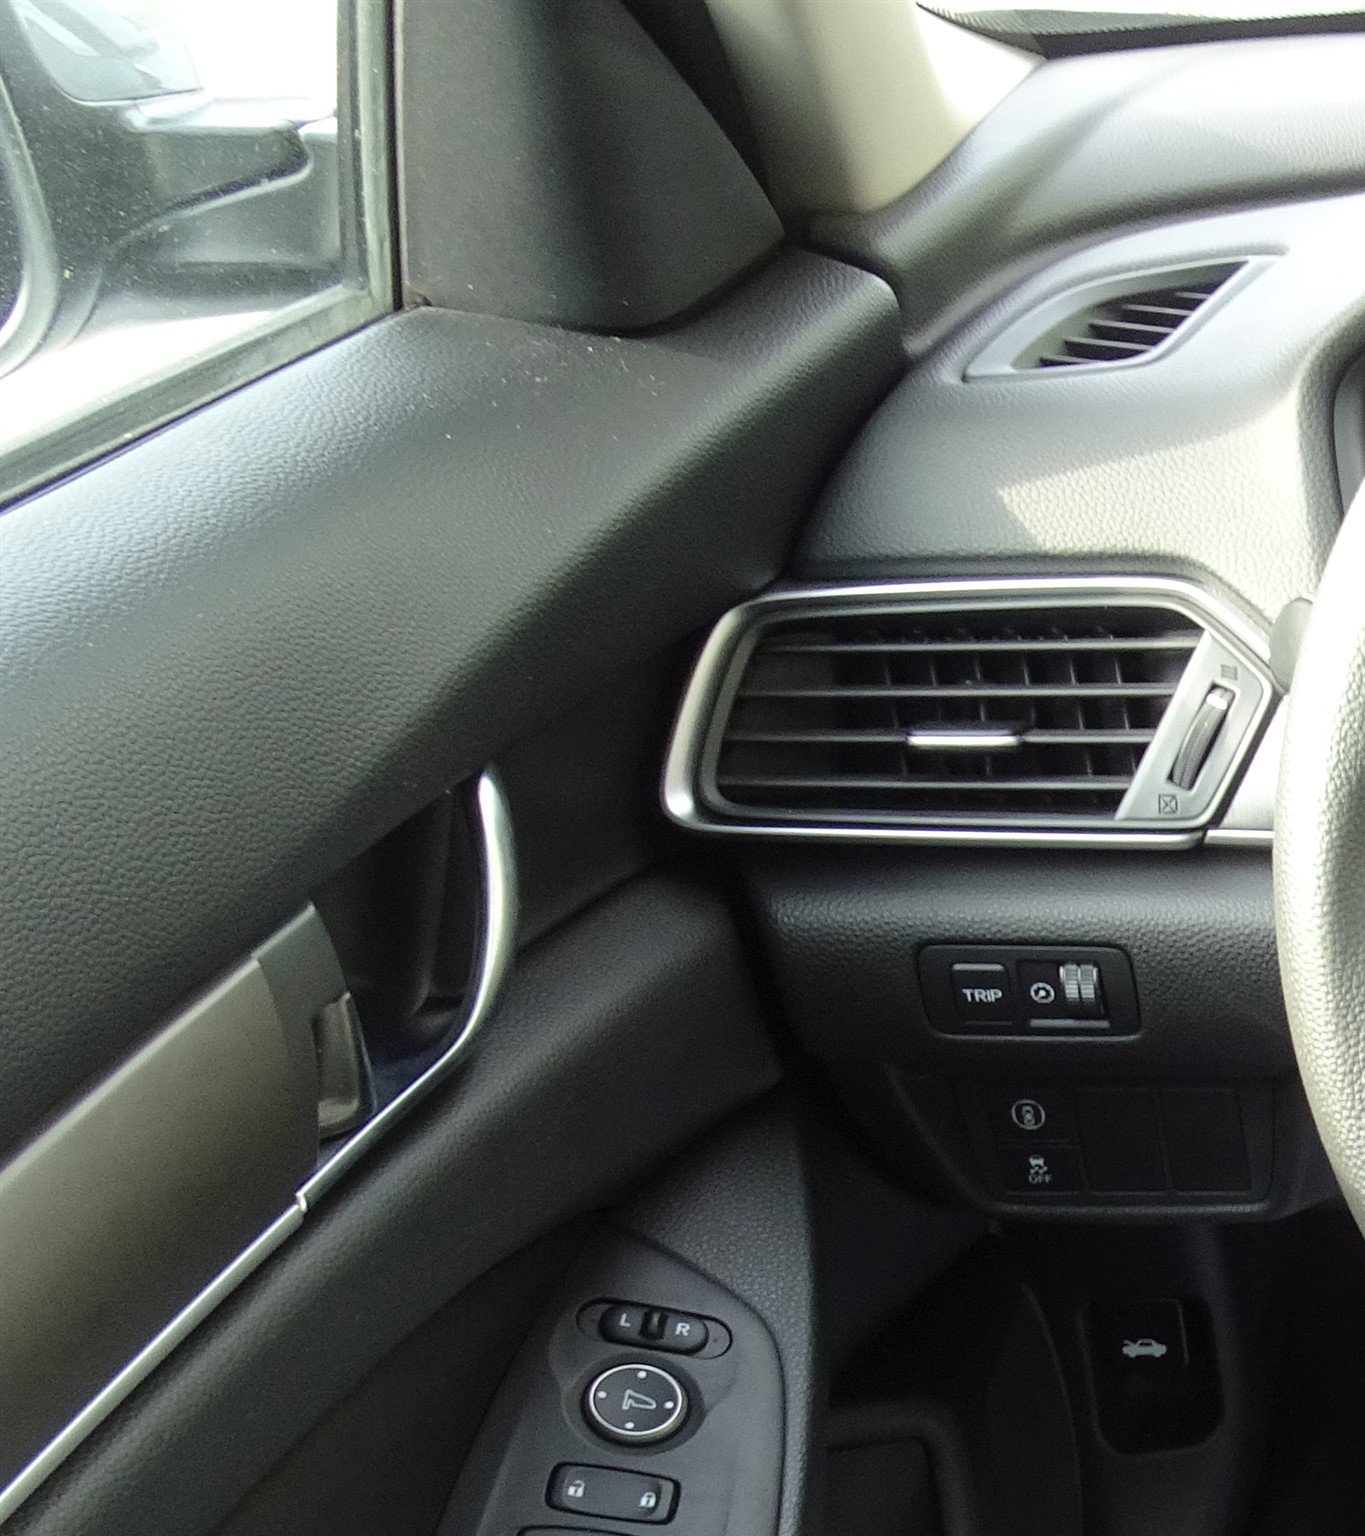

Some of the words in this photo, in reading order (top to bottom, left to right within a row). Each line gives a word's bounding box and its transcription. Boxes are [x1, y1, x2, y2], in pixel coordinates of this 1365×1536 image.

[962, 988, 1003, 1003] TRIP
[619, 1313, 632, 1328] L
[675, 1322, 690, 1336] R
